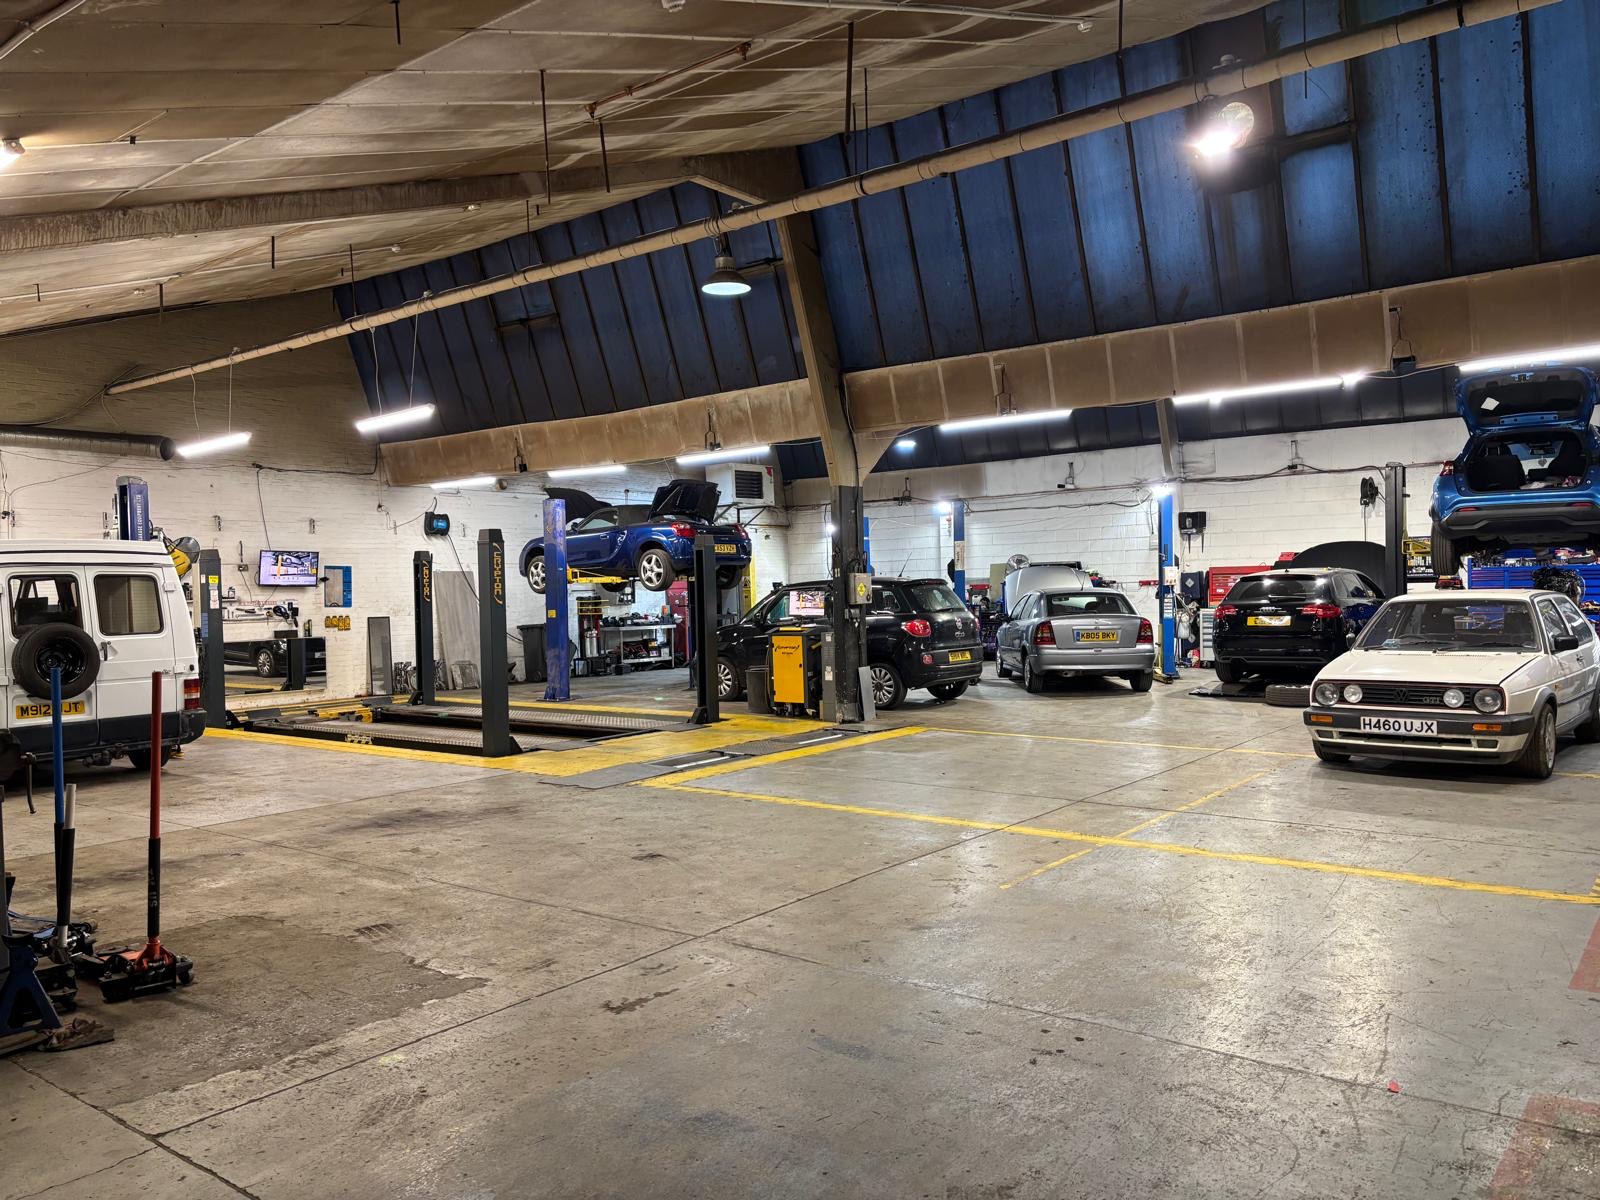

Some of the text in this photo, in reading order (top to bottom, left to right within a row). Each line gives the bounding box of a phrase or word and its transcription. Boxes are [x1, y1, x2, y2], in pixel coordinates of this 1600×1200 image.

[1422, 696, 1441, 704] GTI
[20, 704, 51, 717] M912
[1362, 718, 1435, 734] H460 UJX
